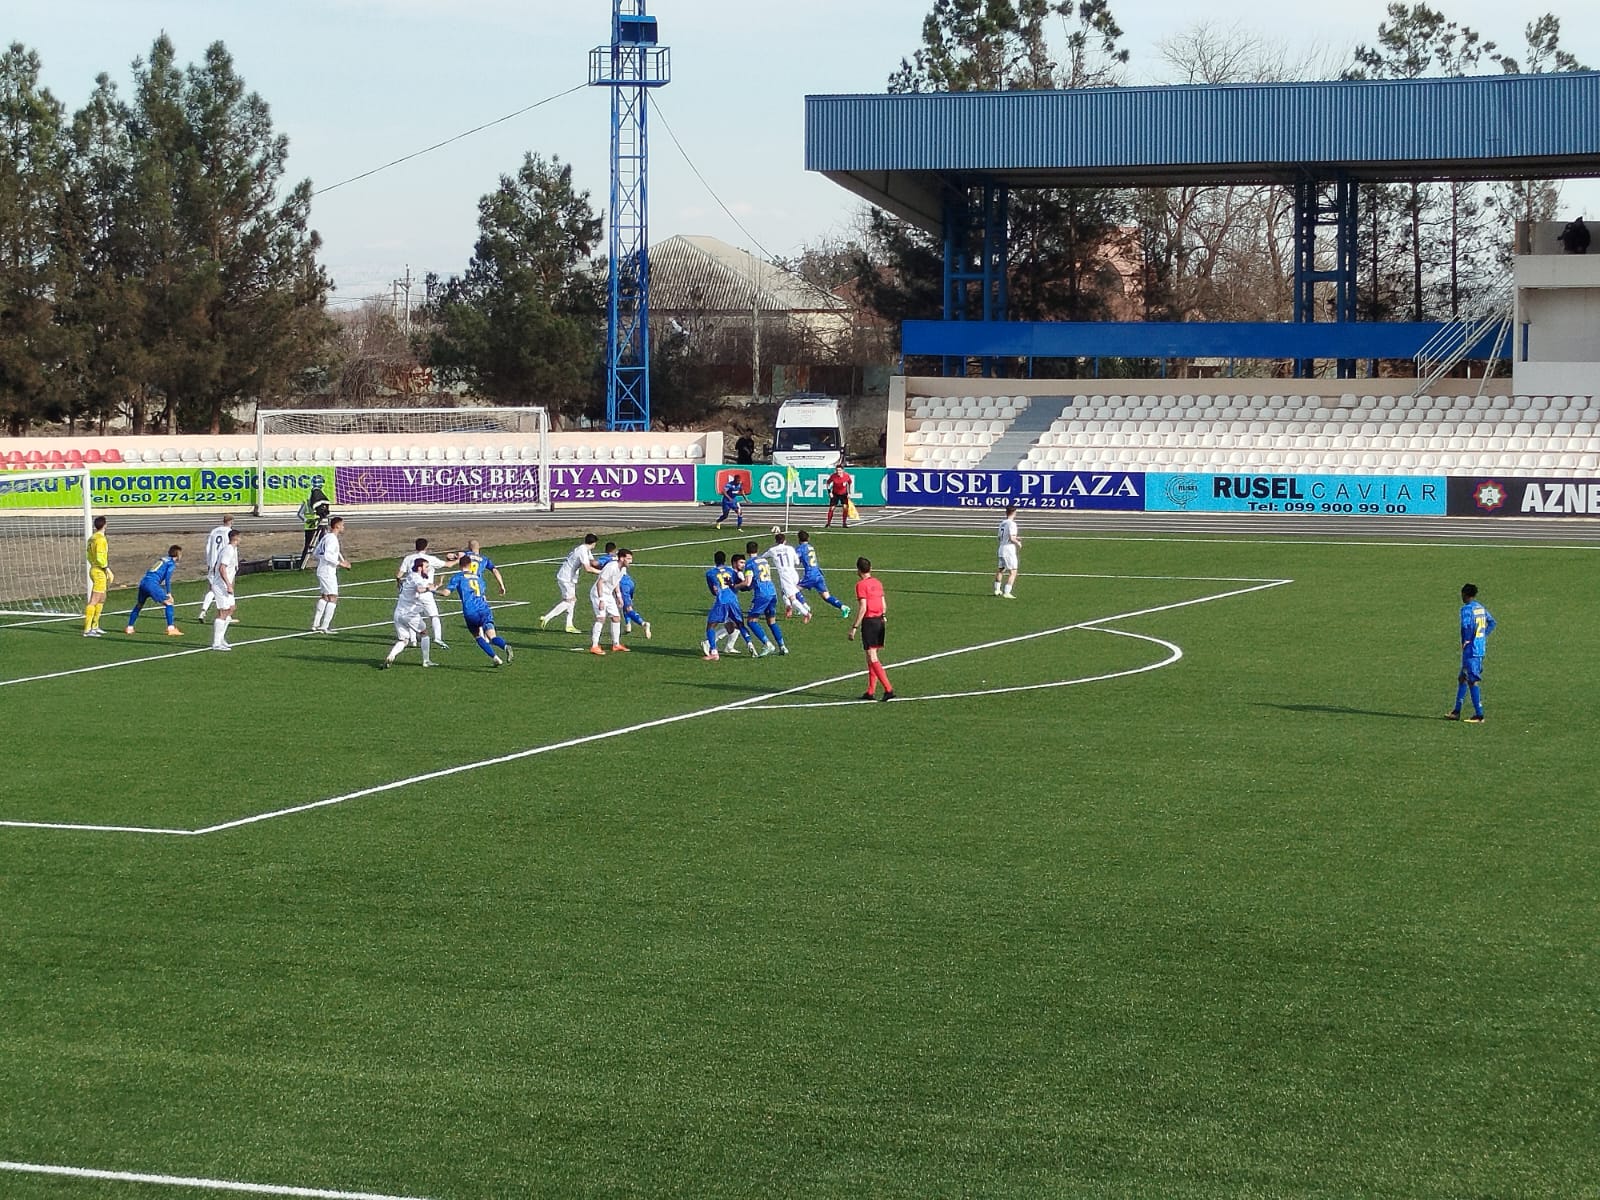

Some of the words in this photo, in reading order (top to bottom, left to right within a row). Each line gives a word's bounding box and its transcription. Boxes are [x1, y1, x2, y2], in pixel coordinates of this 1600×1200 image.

[201, 470, 325, 489] Residence
[403, 468, 482, 486] VEGAS
[491, 468, 585, 485] BEATY
[589, 468, 638, 485] AND
[644, 467, 686, 485] SPA
[760, 471, 863, 498] @AzPL
[896, 472, 1011, 494] RUSEL
[1020, 474, 1139, 497] PLAZA
[90, 494, 114, 502] el:
[120, 493, 152, 502] 050
[158, 493, 241, 502] 274-22-91
[550, 489, 570, 498] 74
[575, 489, 595, 498] 22
[600, 489, 621, 498] 66
[1213, 477, 1304, 499] RUSEL
[1311, 483, 1438, 500] CAVIAR
[958, 496, 982, 506] Tel.
[986, 497, 1009, 507] 050
[1013, 497, 1037, 507] 274
[1041, 498, 1056, 507] 22
[1060, 498, 1075, 508] 01
[1248, 501, 1278, 511] Tel:
[1284, 502, 1315, 512] 099
[1321, 502, 1353, 512] 900
[1359, 503, 1380, 512] 99
[1386, 504, 1407, 513] 00
[1520, 483, 1600, 513] AZNE
[215, 535, 223, 550] 9
[777, 552, 790, 567] 11
[469, 579, 481, 597] 4
